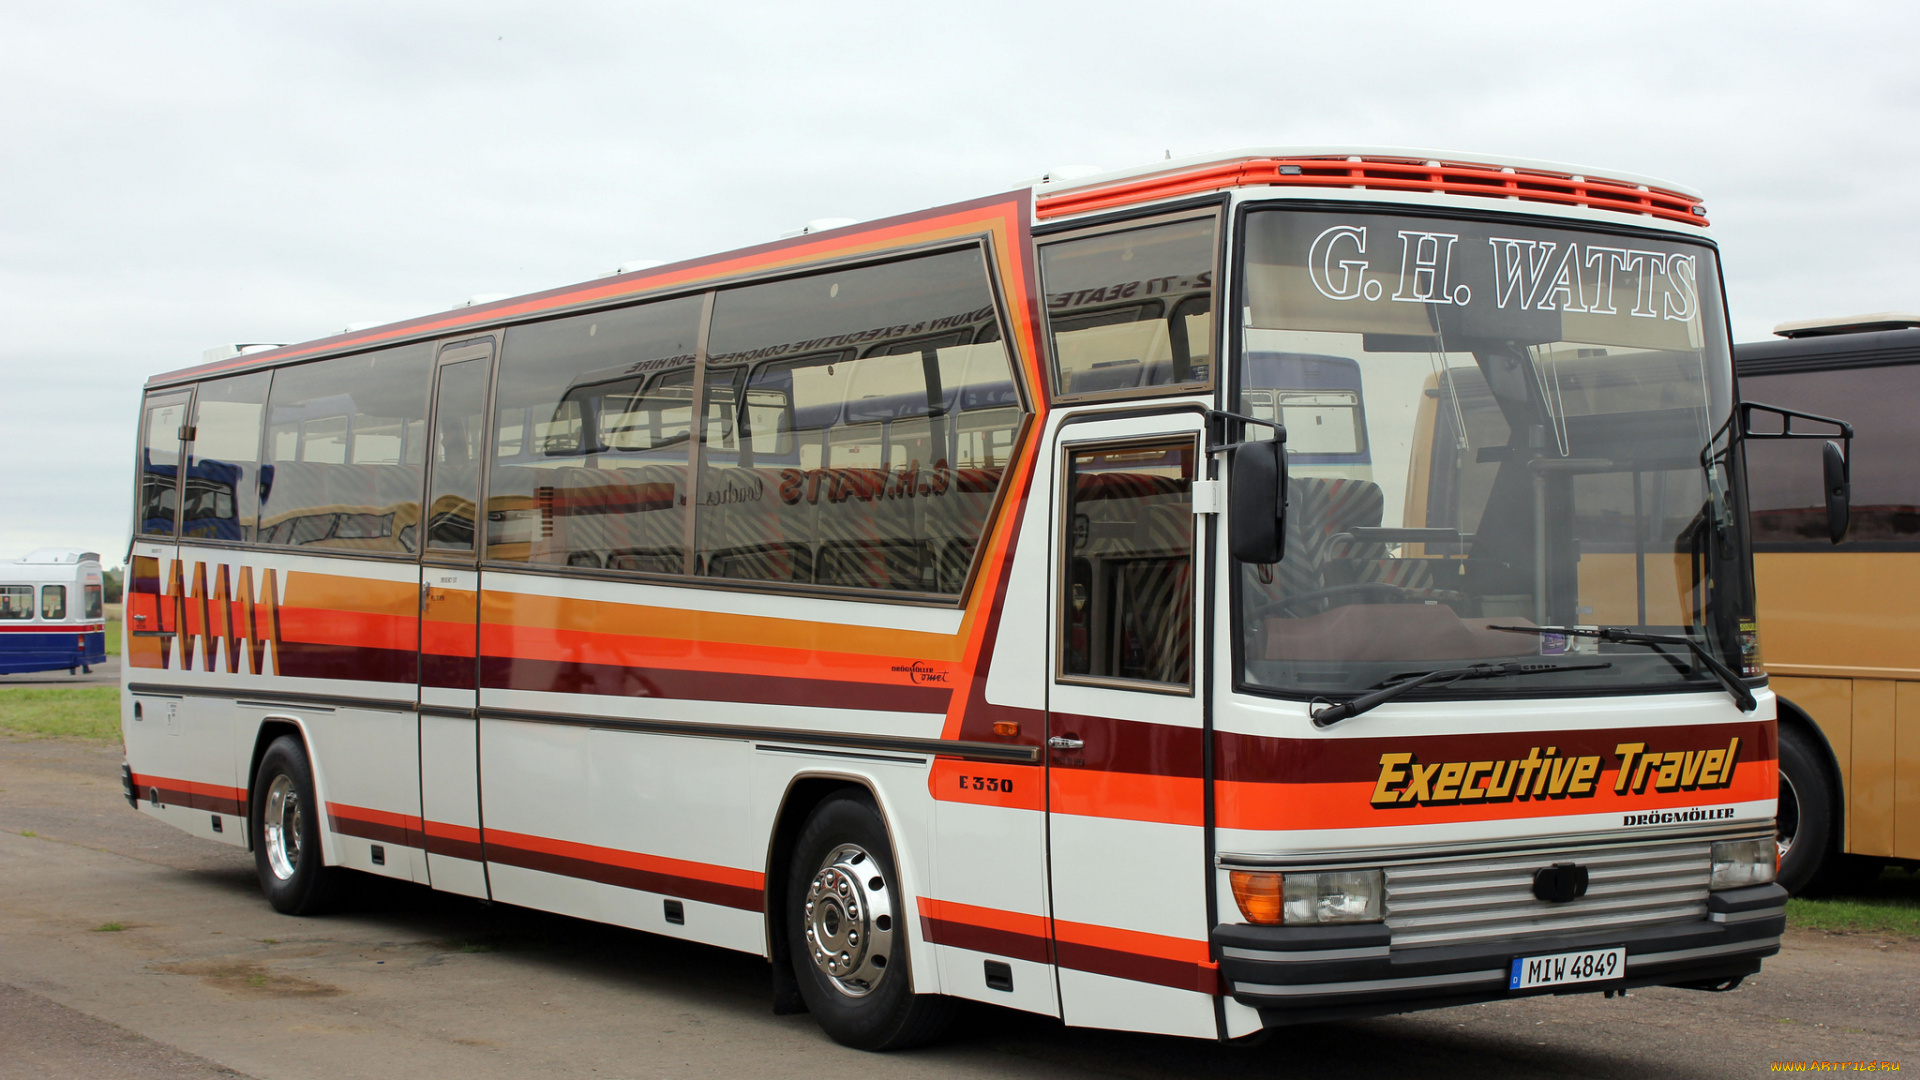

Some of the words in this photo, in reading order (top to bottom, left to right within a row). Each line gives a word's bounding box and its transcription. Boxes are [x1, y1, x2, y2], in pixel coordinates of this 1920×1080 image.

[1308, 225, 1382, 302] G.
[1392, 230, 1472, 306] H.
[1489, 237, 1697, 322] WATTS
[959, 775, 969, 790] E
[972, 777, 1014, 793] 330
[1370, 746, 1606, 809] Executive
[1613, 737, 1743, 796] Travel
[1623, 808, 1735, 827] DRÖGMÖLLER
[1528, 957, 1567, 984] MIW
[1570, 952, 1618, 979] 4849
